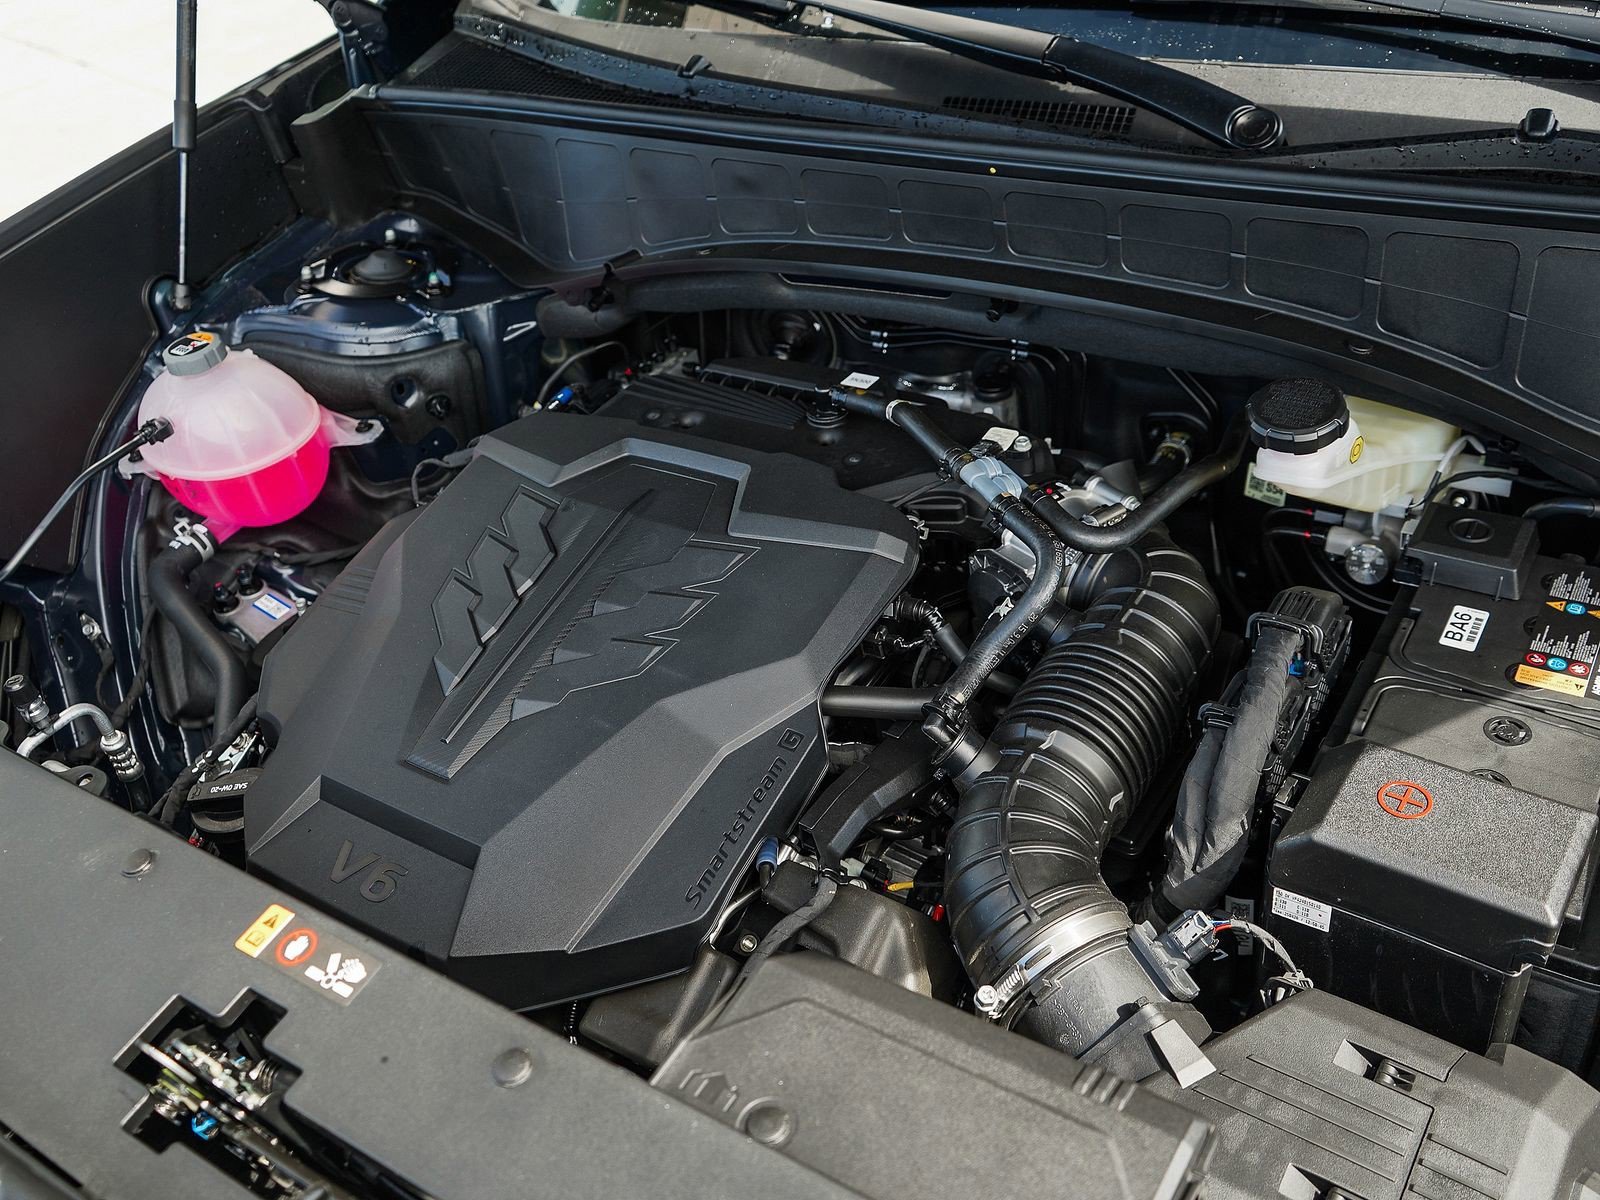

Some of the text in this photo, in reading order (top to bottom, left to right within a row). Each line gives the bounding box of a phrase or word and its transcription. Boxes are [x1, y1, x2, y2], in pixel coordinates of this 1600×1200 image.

[1018, 622, 1029, 633] 15
[1028, 612, 1039, 623] 20
[1444, 611, 1474, 643] BA6
[210, 782, 249, 794] SAE 0W-20
[685, 729, 802, 910] Smartstream G
[330, 839, 409, 903] V6
